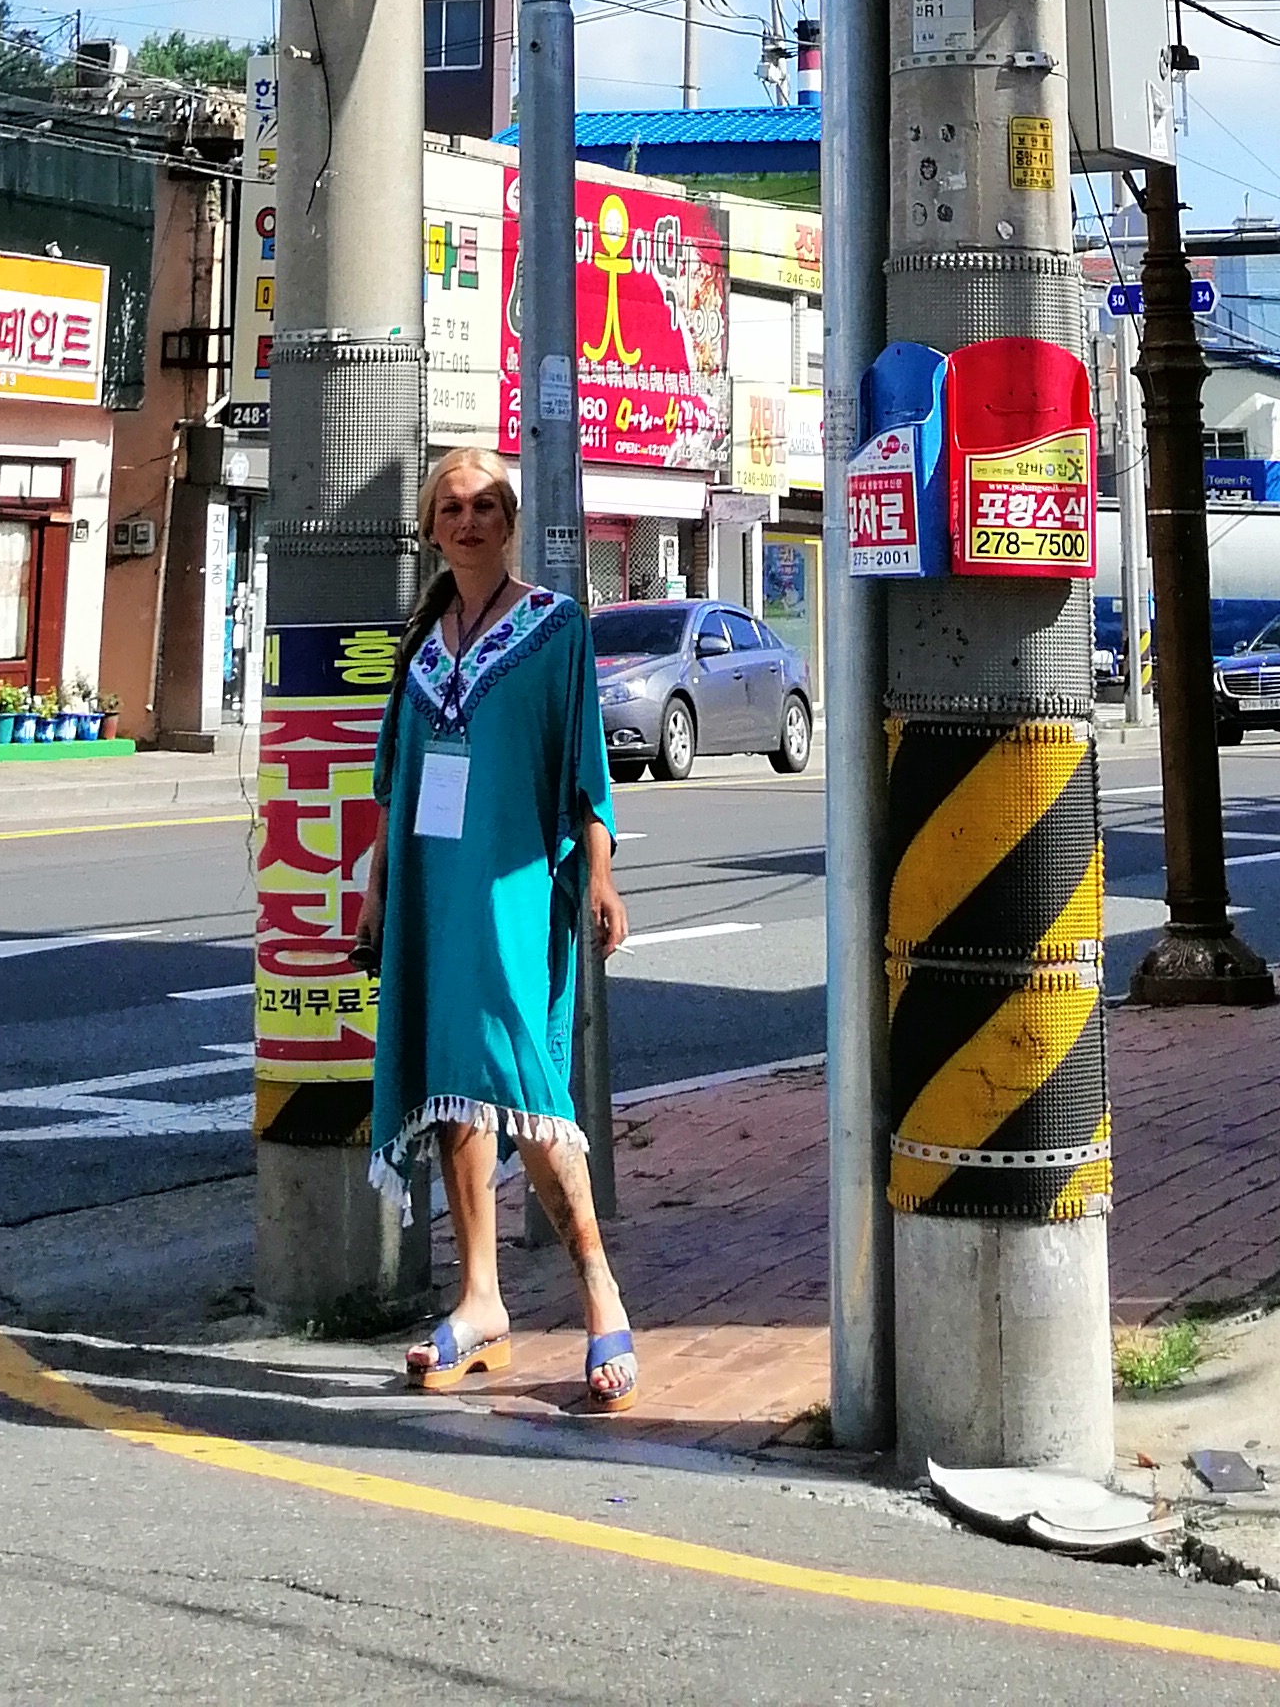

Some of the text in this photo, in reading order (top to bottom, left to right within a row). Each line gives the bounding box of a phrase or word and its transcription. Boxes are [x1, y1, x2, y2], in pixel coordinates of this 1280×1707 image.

[1111, 293, 1126, 307] 30
[1196, 290, 1211, 304] 34
[431, 350, 470, 374] YT-016
[432, 387, 477, 411] 248-1786
[976, 492, 1087, 529] 포항소식
[975, 530, 1085, 558] 278-7500
[853, 550, 910, 567] 275-2001
